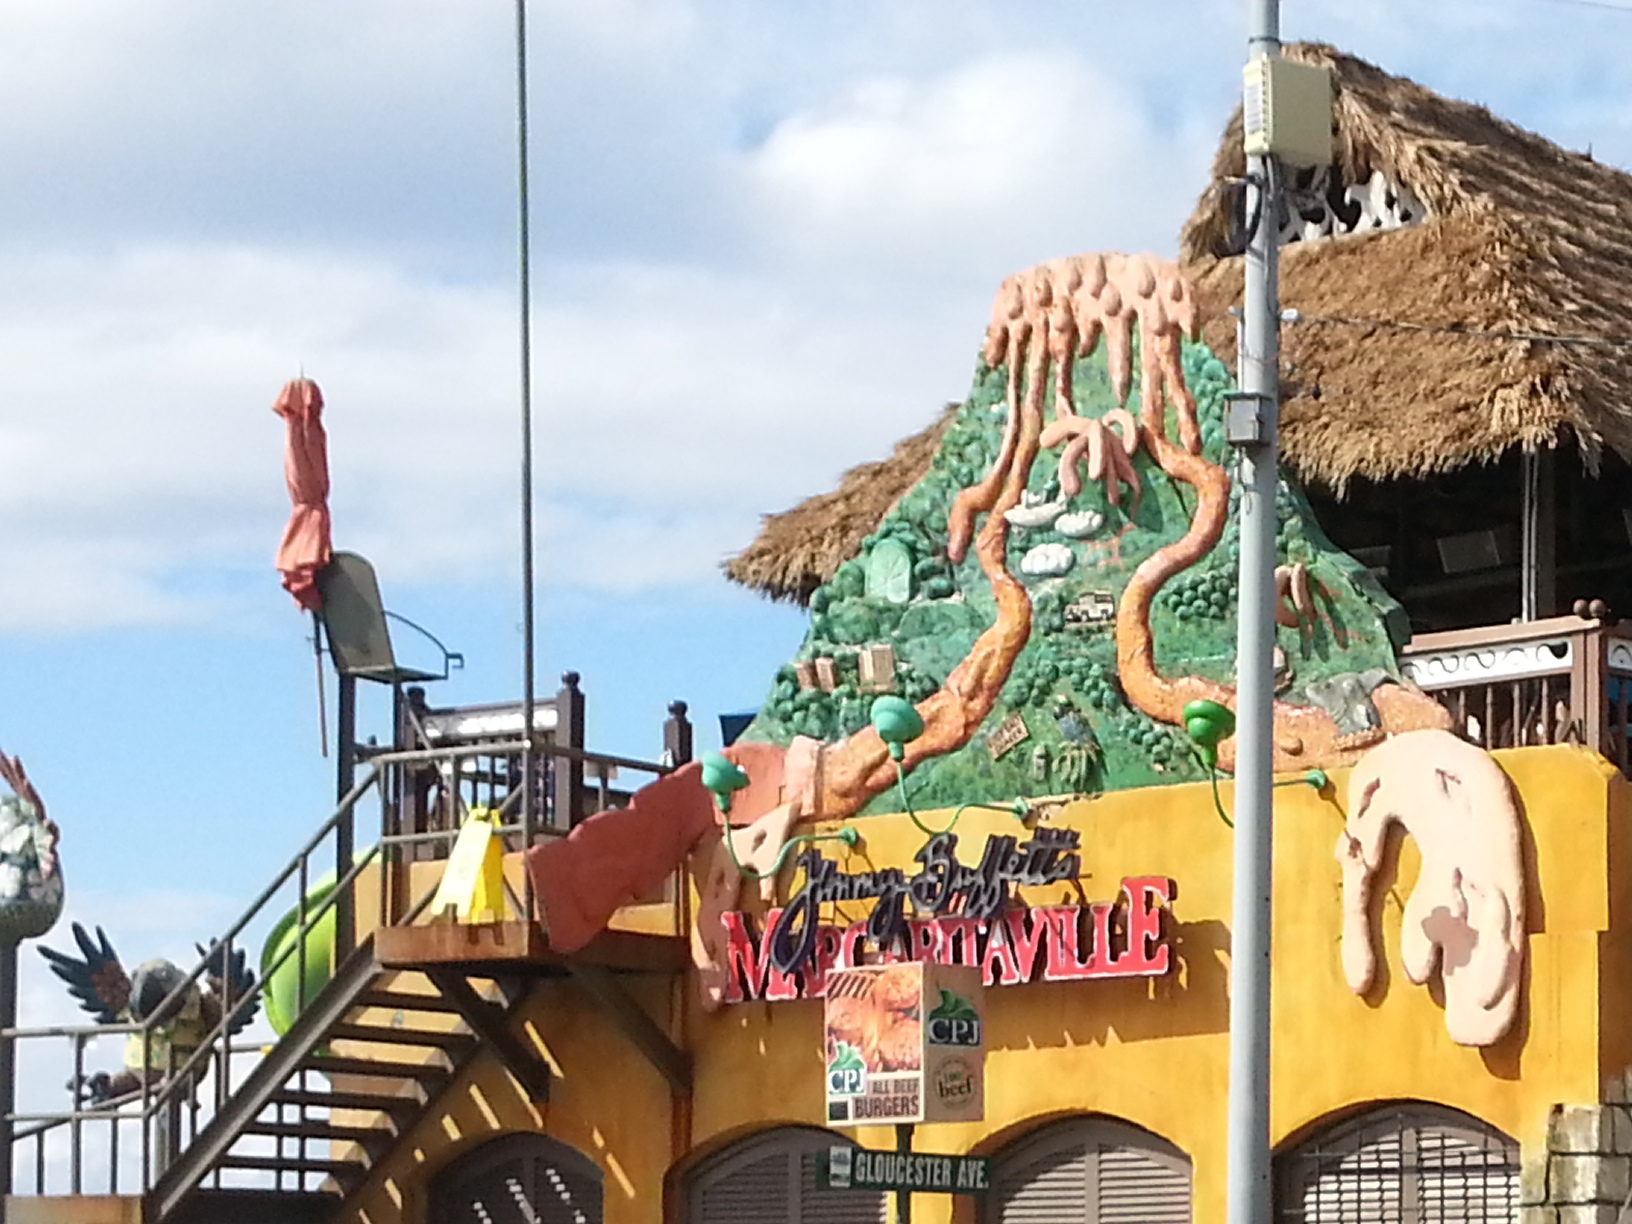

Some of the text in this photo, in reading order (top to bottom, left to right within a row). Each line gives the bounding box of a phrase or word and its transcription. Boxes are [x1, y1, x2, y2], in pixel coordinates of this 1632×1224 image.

[770, 848, 905, 974] Jimmy
[929, 1018, 979, 1044] CPJ
[829, 1069, 866, 1093] CPJ
[872, 1078, 919, 1095] ALL BEEF
[854, 1095, 919, 1118] BURGERS
[855, 1152, 951, 1187] GLOUCESTER
[956, 1159, 989, 1189] AVE.
